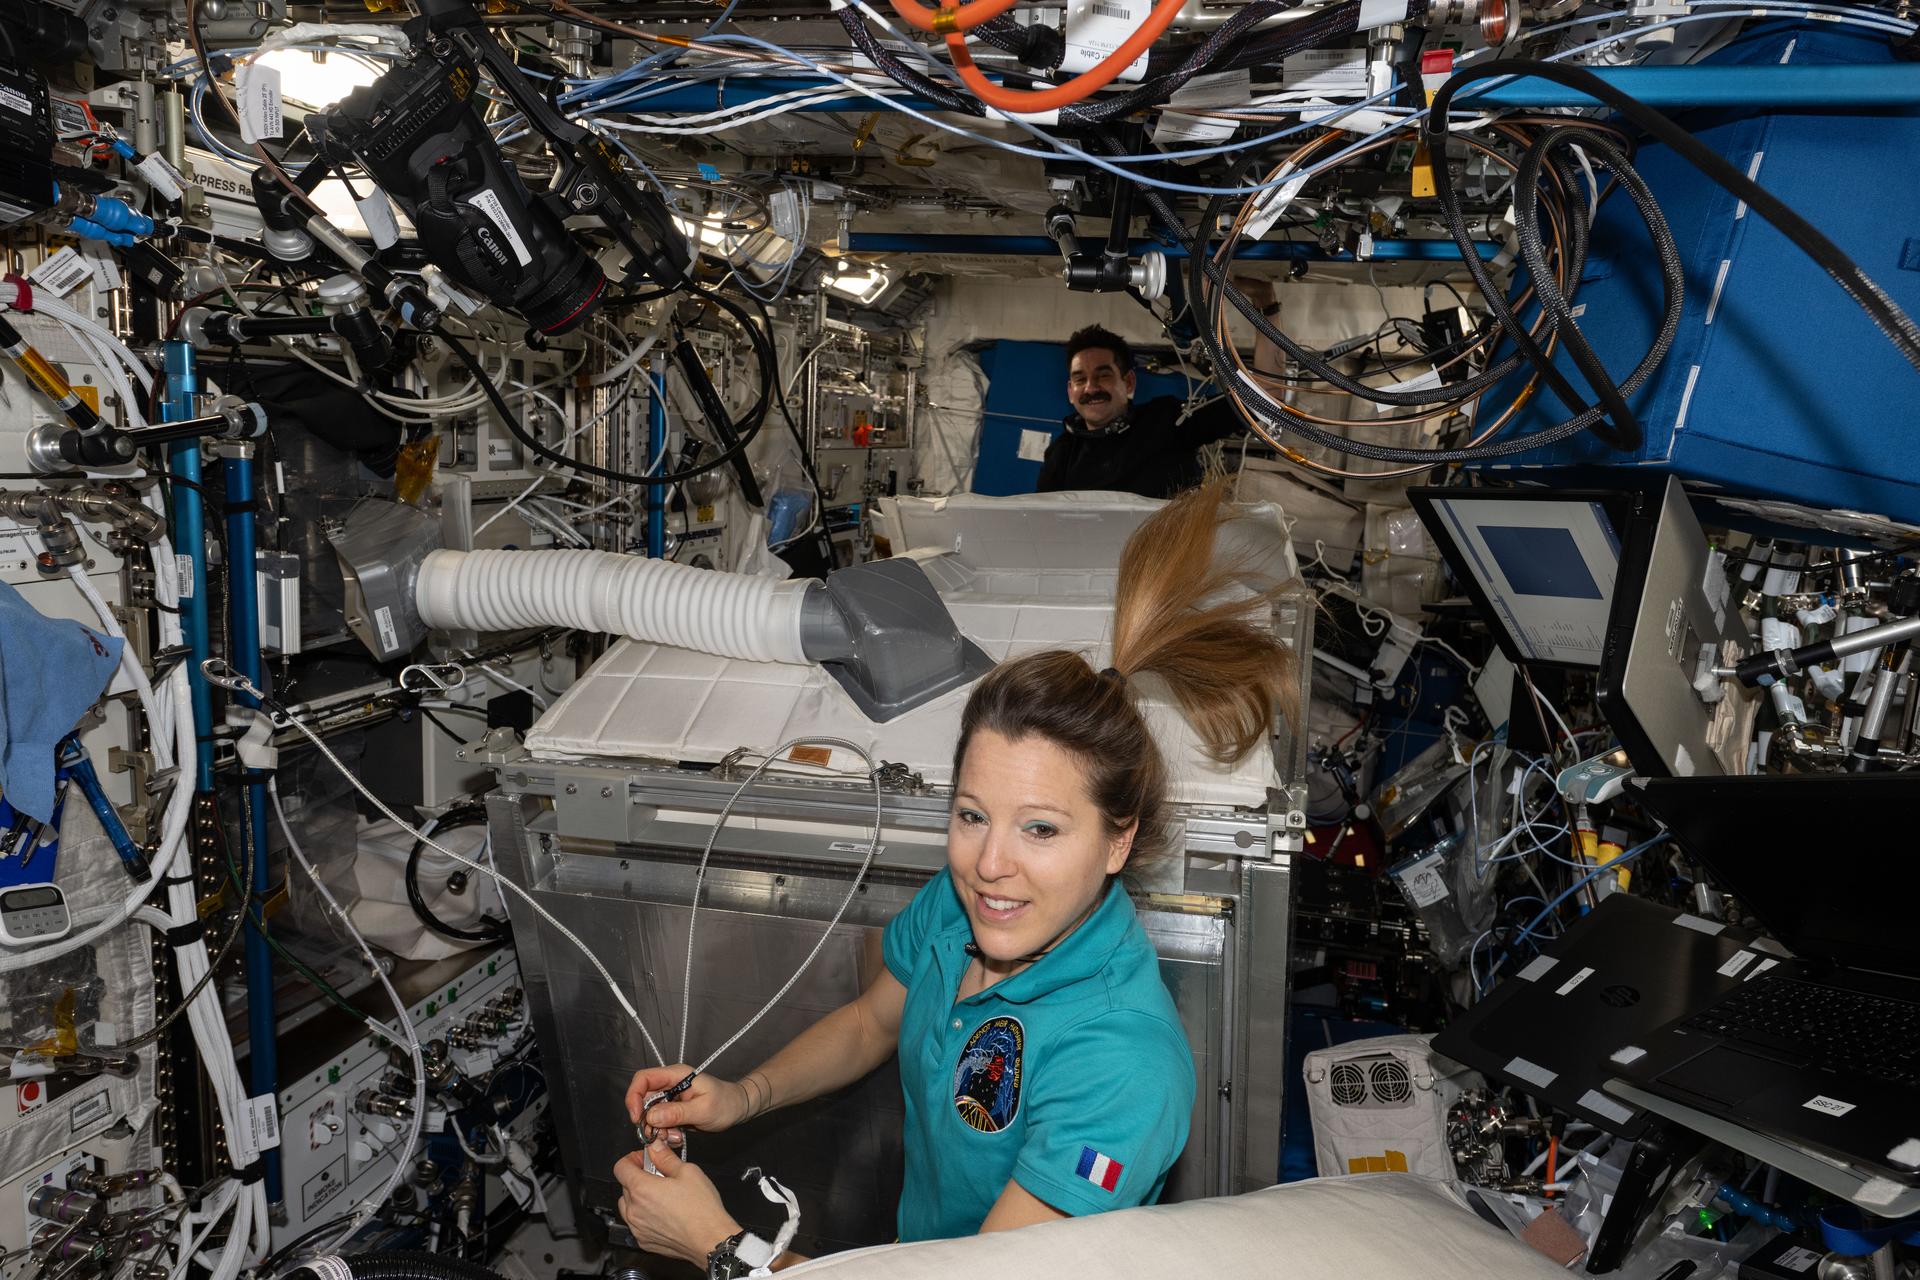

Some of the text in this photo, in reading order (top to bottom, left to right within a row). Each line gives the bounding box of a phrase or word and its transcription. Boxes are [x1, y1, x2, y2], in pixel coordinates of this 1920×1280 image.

[1080, 47, 1101, 60] Cable
[193, 172, 236, 193] XPRESS
[478, 227, 507, 265] Canon
[1812, 1099, 1833, 1108] SSC
[309, 1182, 341, 1211] INDICATION
[314, 1181, 334, 1199] SMOKE
